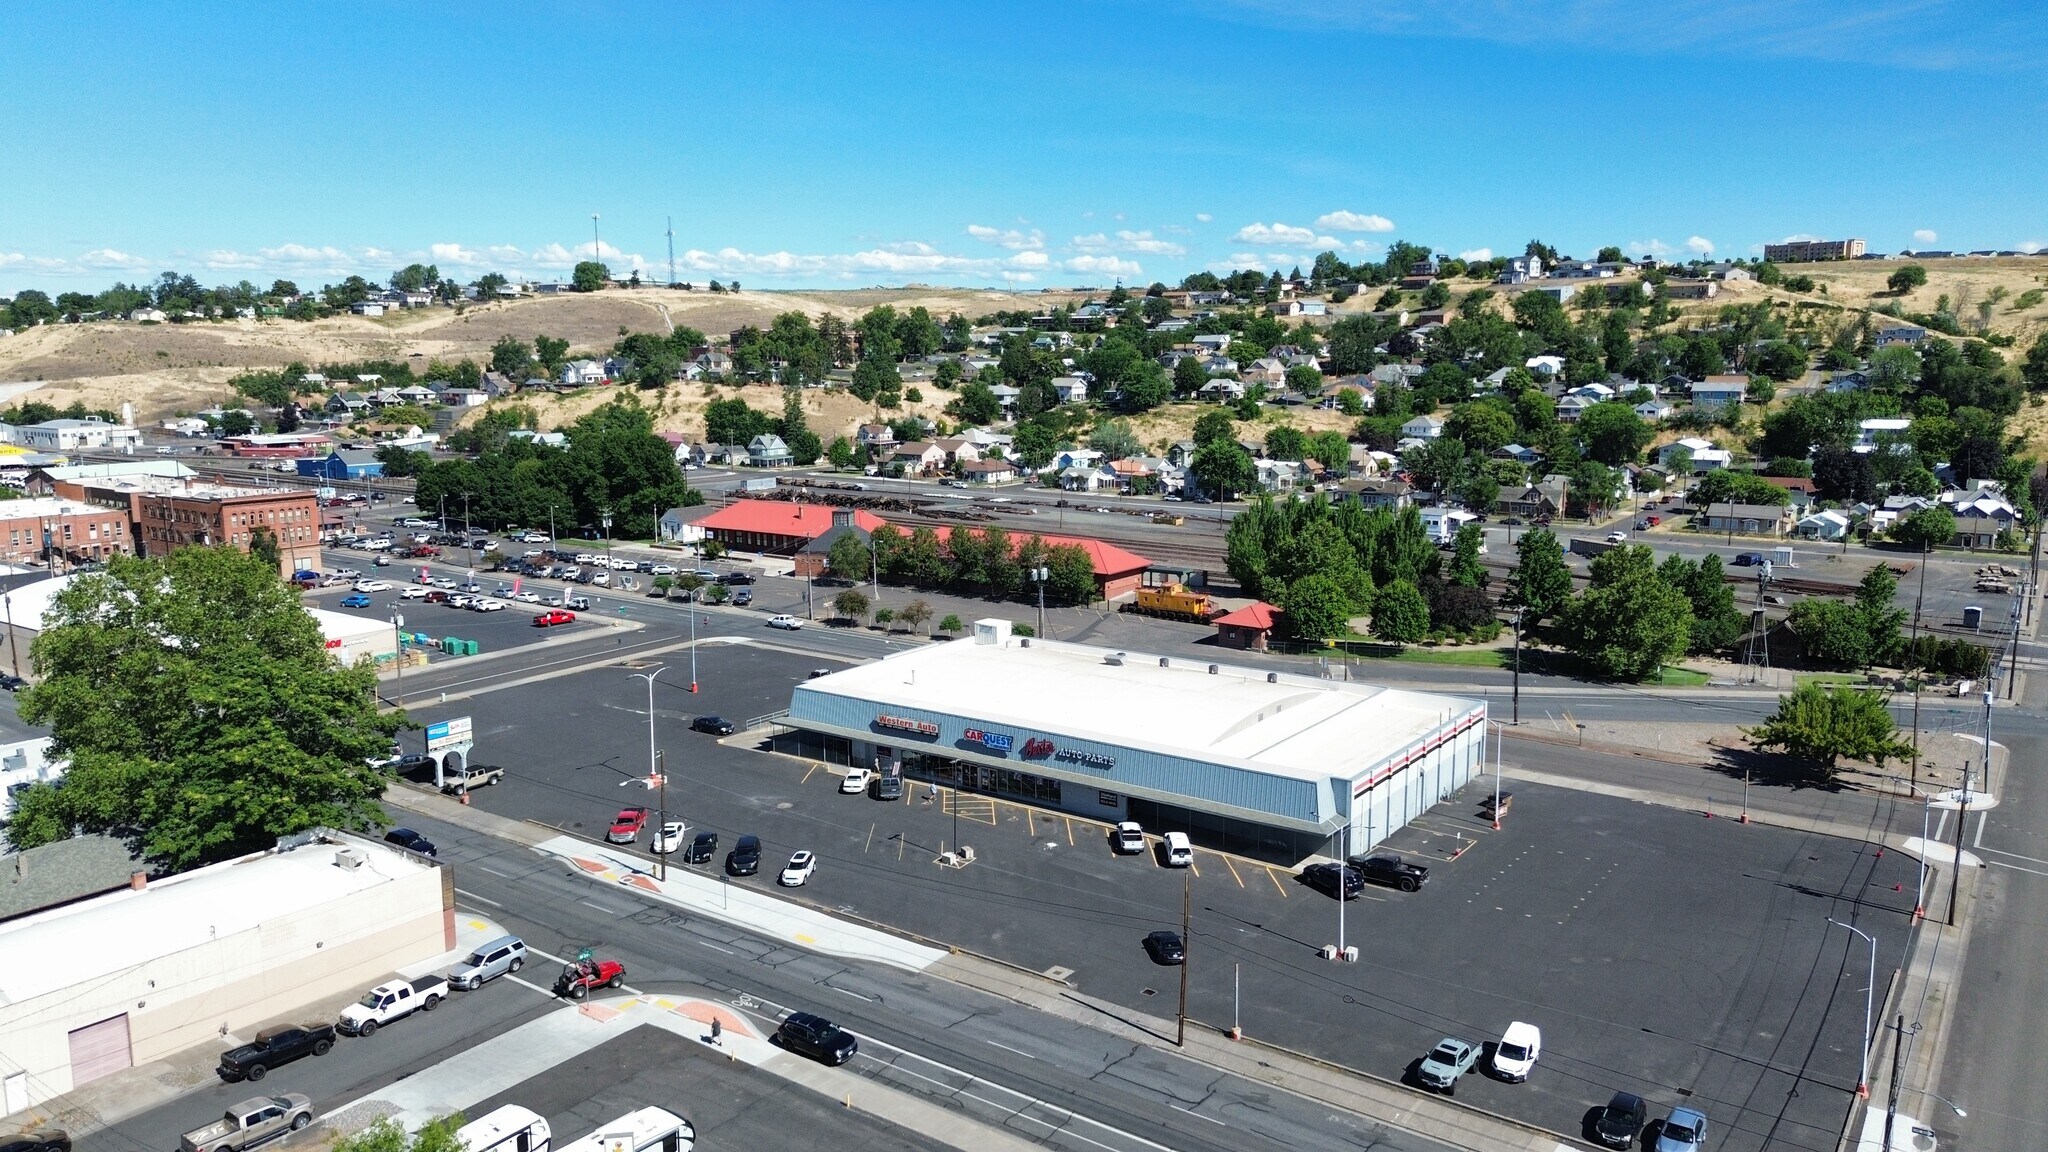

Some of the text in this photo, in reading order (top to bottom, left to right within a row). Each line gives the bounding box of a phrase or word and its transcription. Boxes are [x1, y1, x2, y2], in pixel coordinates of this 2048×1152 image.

[879, 715, 914, 728] Western
[917, 720, 937, 732] Auto
[965, 730, 1012, 747] CARQUEST
[1059, 748, 1083, 760] AUTO
[1086, 753, 1115, 766] PARTS
